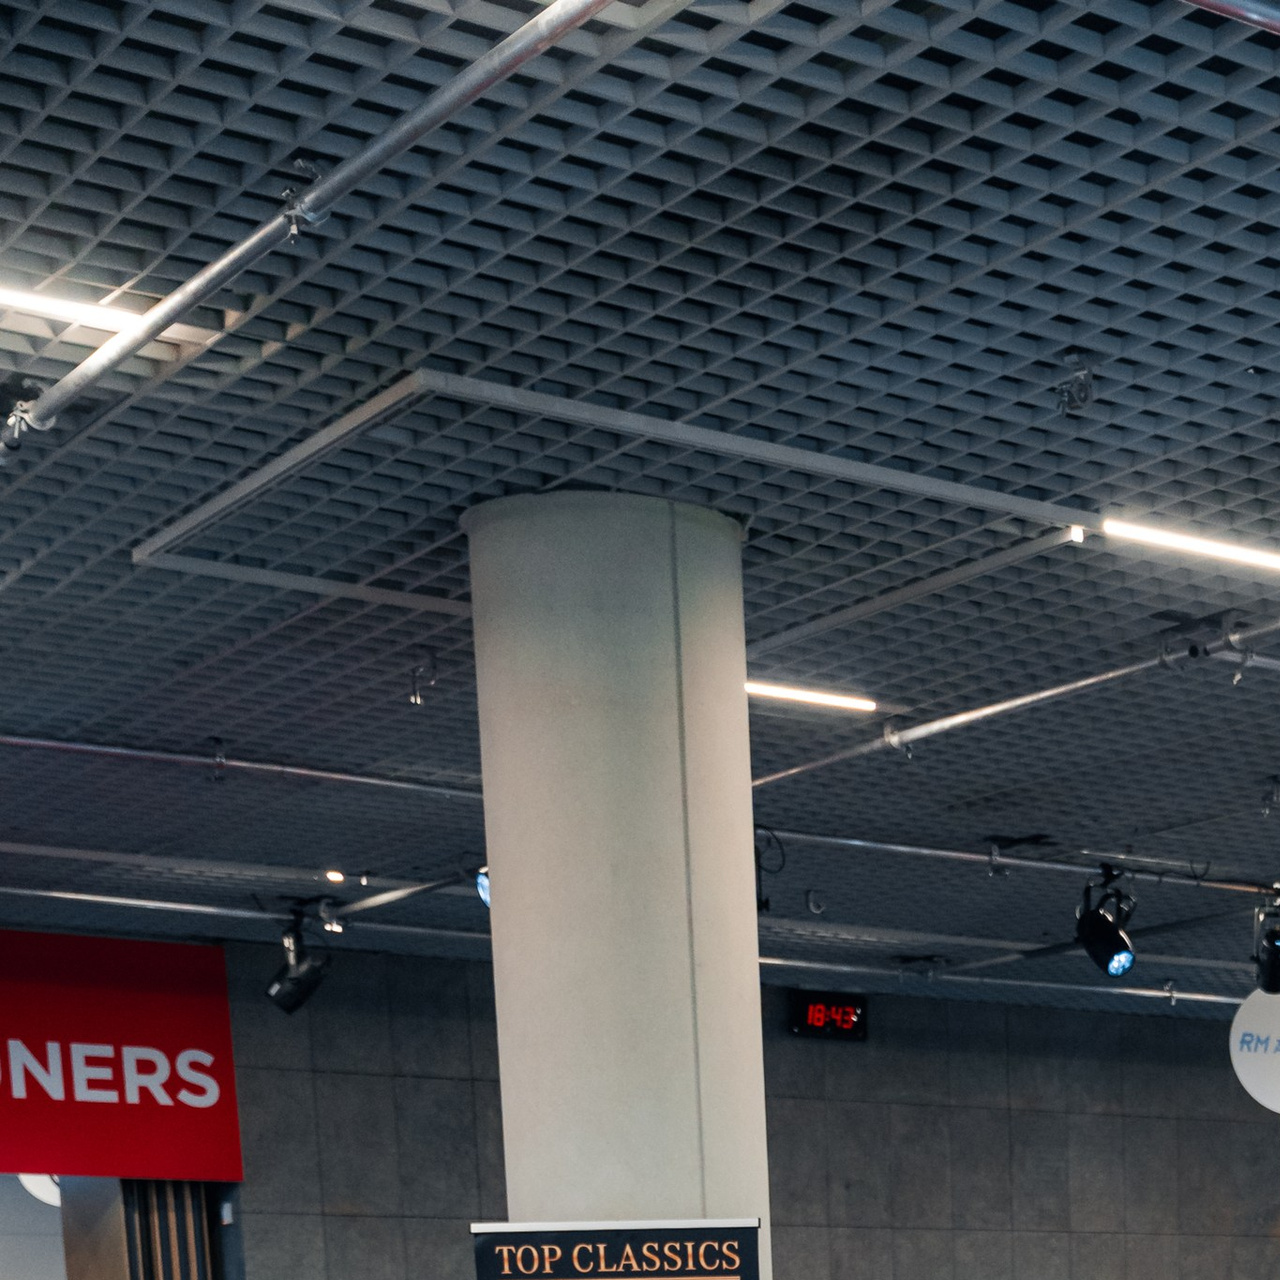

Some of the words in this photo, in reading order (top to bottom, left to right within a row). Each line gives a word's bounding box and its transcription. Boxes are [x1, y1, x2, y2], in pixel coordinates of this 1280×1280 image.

[806, 1004, 856, 1030] 18:43
[1239, 1031, 1270, 1054] RM
[0, 1038, 221, 1109] NERS
[495, 1244, 562, 1275] TOP
[571, 1240, 742, 1273] CLASSICS
